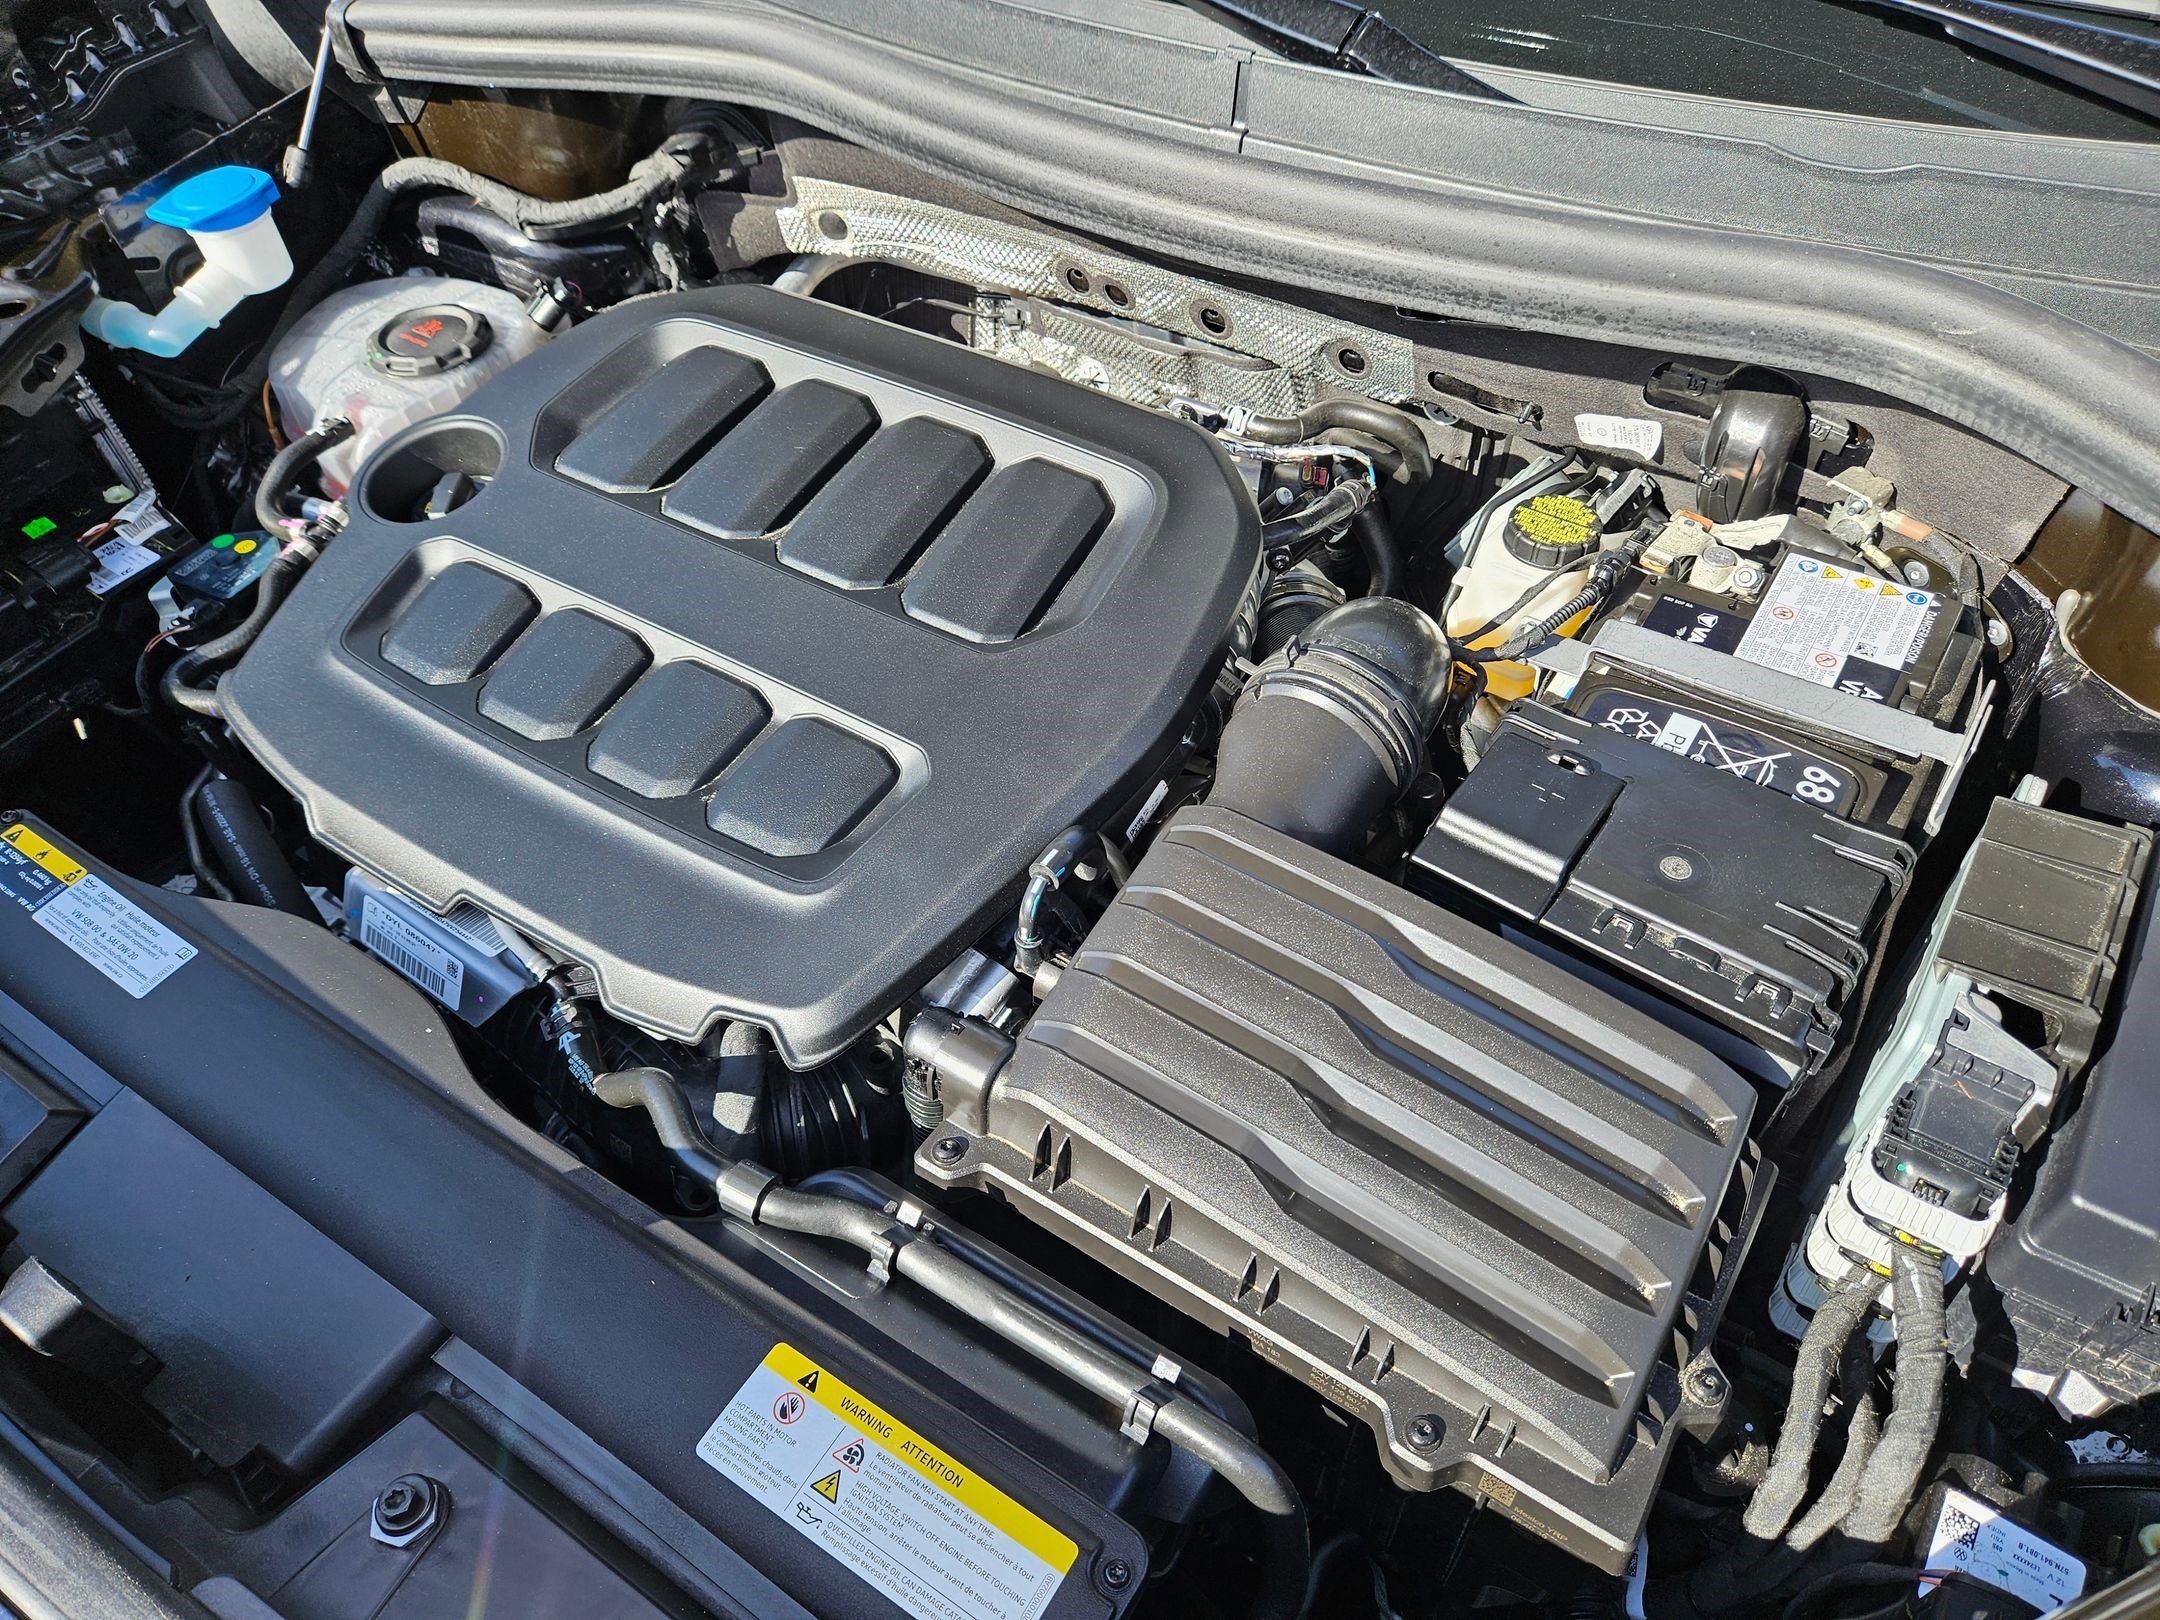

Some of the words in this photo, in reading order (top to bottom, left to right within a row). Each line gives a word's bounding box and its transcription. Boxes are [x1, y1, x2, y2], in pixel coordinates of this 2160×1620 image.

[1905, 611, 1937, 665] DANGER/POISON
[1796, 765, 1840, 805] 68
[69, 908, 86, 920] VW
[80, 916, 95, 927] 508
[90, 924, 103, 933] 00
[105, 935, 120, 946] SAE
[115, 943, 139, 961] 0W-20
[95, 890, 119, 907] Engine
[113, 903, 126, 912] Oil
[124, 911, 142, 924] Huile
[137, 920, 161, 938] moteur
[722, 1415, 749, 1436] MOVING
[746, 1432, 769, 1451] PARTS.
[727, 1407, 776, 1444] COMPARTMENT.
[734, 1400, 749, 1413] HOT
[746, 1409, 768, 1426] PARTS
[765, 1422, 775, 1431] IN
[772, 1427, 797, 1448] MOTOR
[838, 1396, 893, 1439] WARNING
[899, 1439, 964, 1488] ATTENTION
[702, 1441, 724, 1459] Pièces
[721, 1456, 732, 1466] en
[728, 1463, 770, 1494] mouvement.
[708, 1432, 718, 1442] le
[714, 1438, 762, 1475] compartiment
[714, 1424, 752, 1454] Composants
[749, 1449, 764, 1463] très
[760, 1458, 785, 1478] chauds
[781, 1473, 799, 1489] dans
[862, 1469, 893, 1493] moment.
[874, 1451, 908, 1478] RADIATOR
[906, 1473, 921, 1486] FAN
[919, 1482, 936, 1497] MAY
[934, 1493, 955, 1510] START
[953, 1506, 964, 1517] AT
[962, 1512, 978, 1527] ANY
[976, 1522, 996, 1540] TIME.
[835, 1506, 874, 1536] l'allumage.
[848, 1488, 879, 1512] IGNITION
[877, 1508, 906, 1532] SYSTEM.
[868, 1461, 878, 1471] Le
[876, 1467, 913, 1495] ventilateur
[911, 1491, 923, 1502] de
[920, 1498, 952, 1523] radiateur
[949, 1520, 967, 1536] peut
[966, 1532, 976, 1541] se
[975, 1536, 1014, 1567] déclencher
[1012, 1562, 1019, 1570] à
[1017, 1567, 1035, 1582] tout
[818, 1530, 863, 1565] Remplissage
[858, 1558, 888, 1582] excessif
[884, 1577, 910, 1599] d'huile
[825, 1521, 867, 1553] OVERFILLED
[863, 1549, 891, 1571] ENGINE
[888, 1566, 903, 1579] OIL
[900, 1575, 917, 1590] CAN
[914, 1585, 946, 1611] DAMAGE
[842, 1497, 864, 1516] Haute
[887, 1531, 913, 1552] arrêter
[911, 1547, 920, 1557] le
[917, 1553, 945, 1575] moteur
[943, 1571, 962, 1587] avant
[963, 1584, 975, 1596] de
[972, 1592, 1002, 1616] toucher
[999, 1611, 1008, 1620] à
[854, 1480, 872, 1496] HIGH
[899, 1513, 926, 1535] SWITCH
[924, 1530, 941, 1545] OFF
[937, 1540, 965, 1563] ENGINE
[962, 1558, 991, 1581] BEFORE
[988, 1576, 1027, 1607] TOUCHING
